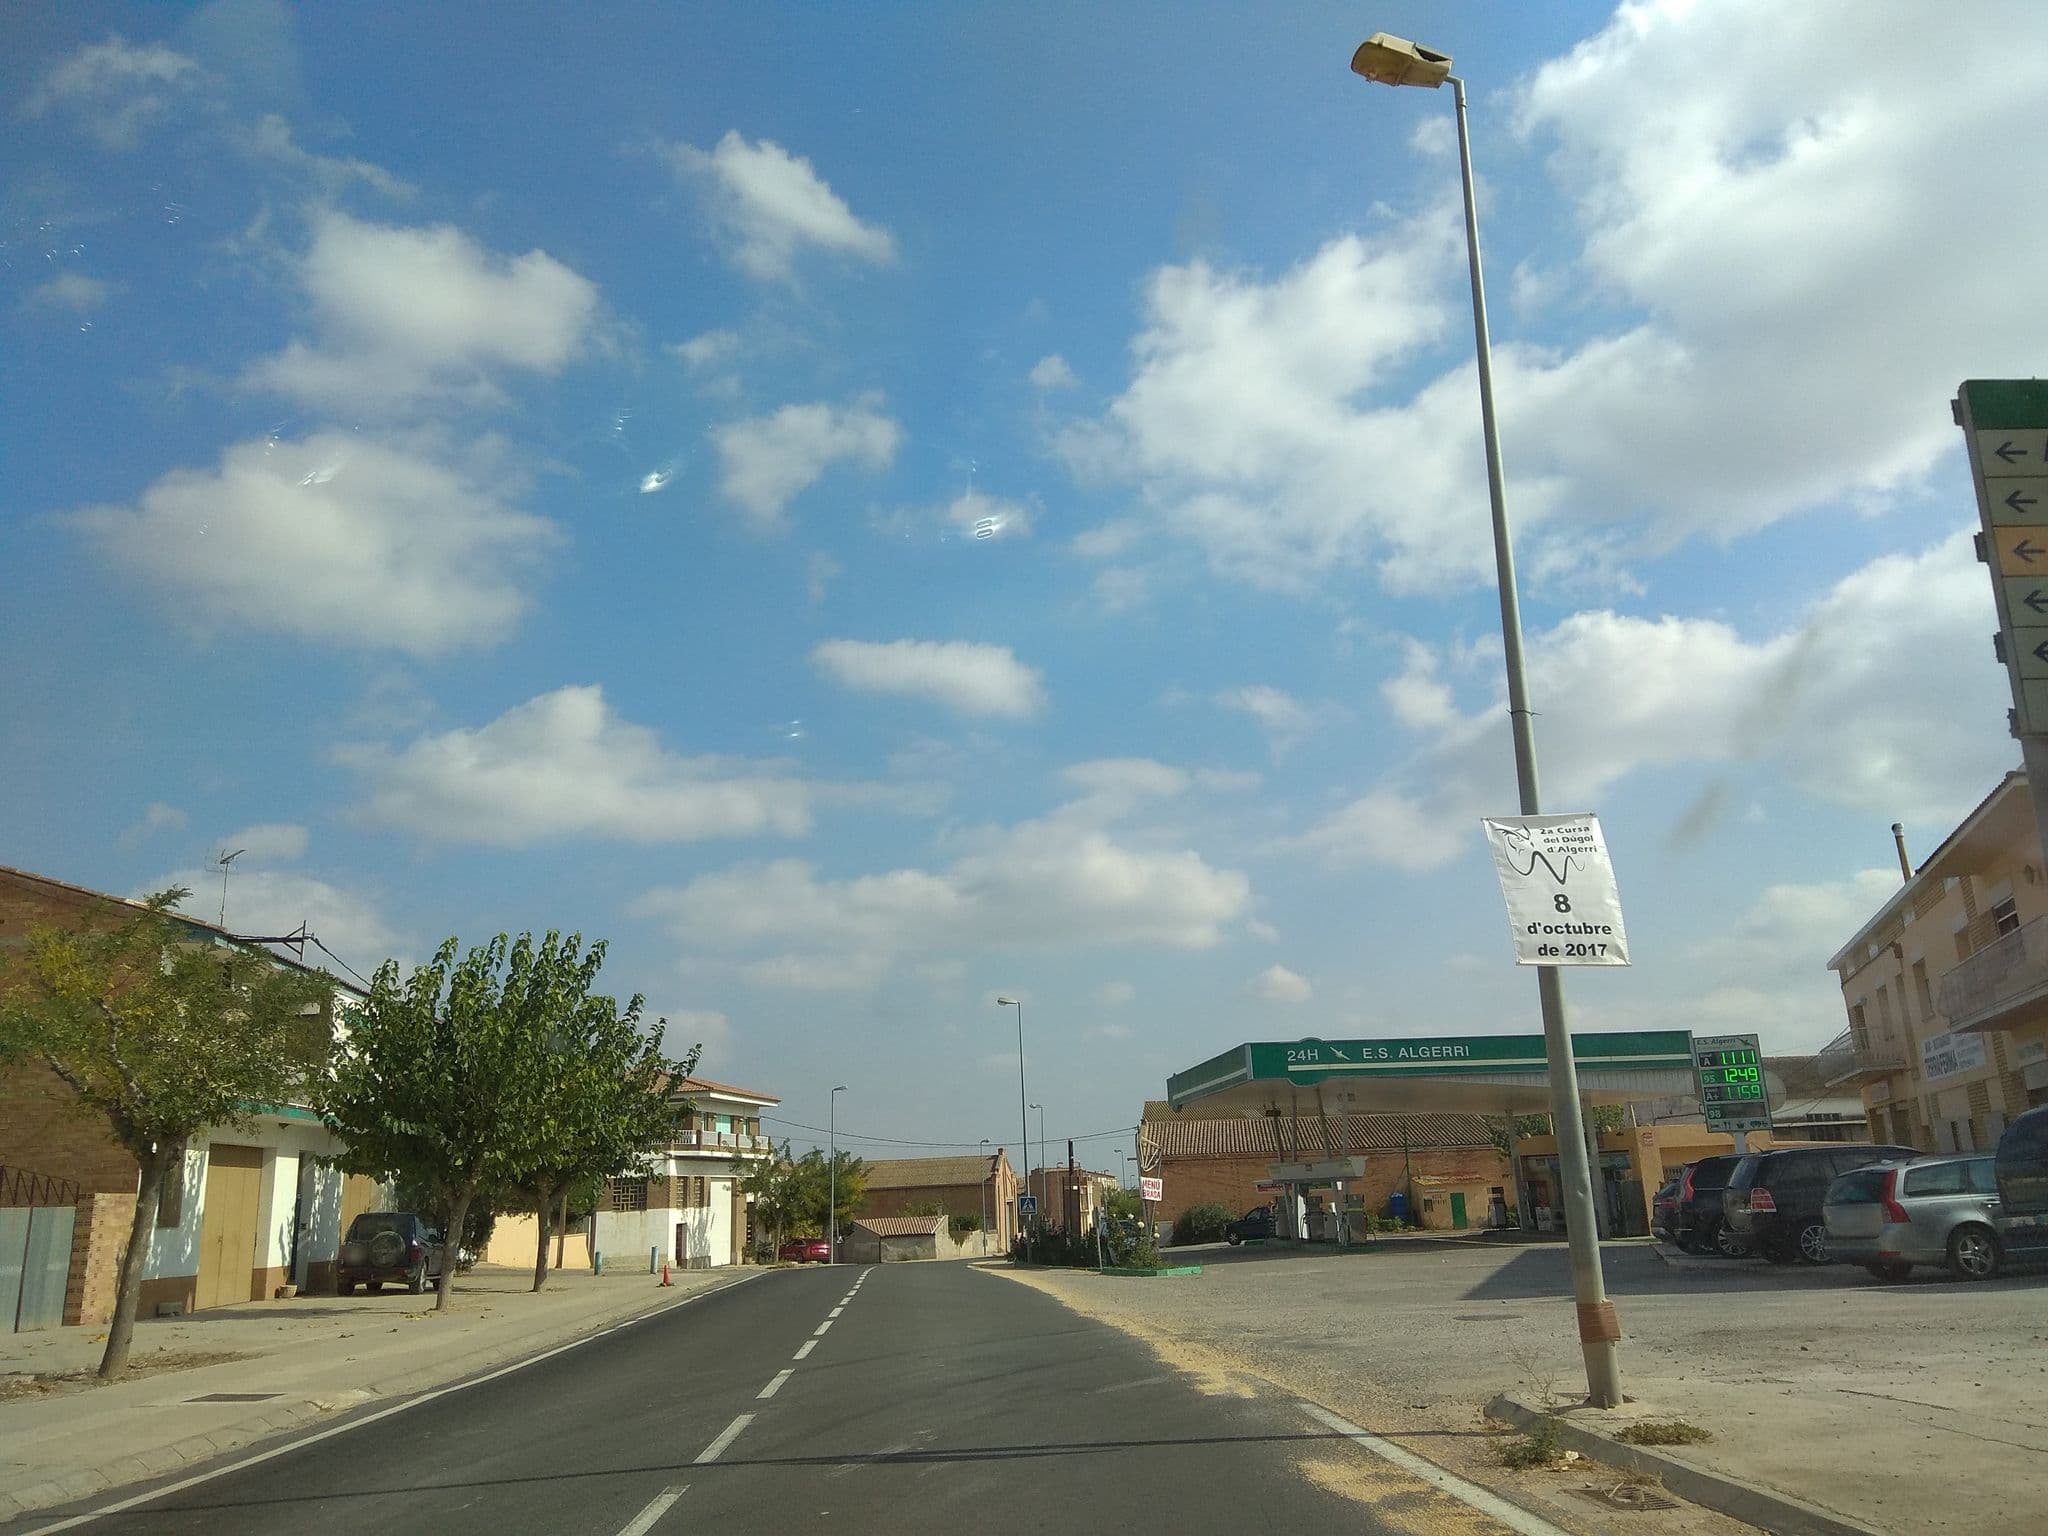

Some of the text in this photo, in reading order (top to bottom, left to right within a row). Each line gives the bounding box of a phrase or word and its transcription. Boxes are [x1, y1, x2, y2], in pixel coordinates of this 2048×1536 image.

[1557, 826, 1590, 834] Cursa
[1562, 835, 1594, 844] Dúgol
[1546, 845, 1597, 854] d'Algerri
[1553, 894, 1571, 913] 8
[1527, 922, 1612, 935] d'octubre
[1537, 943, 1607, 957] de 2017
[1287, 1046, 1470, 1061] 24H E.S. ALGERRI
[1704, 1057, 1711, 1065] A
[1704, 1075, 1716, 1083] 95
[1709, 1110, 1721, 1118] 98
